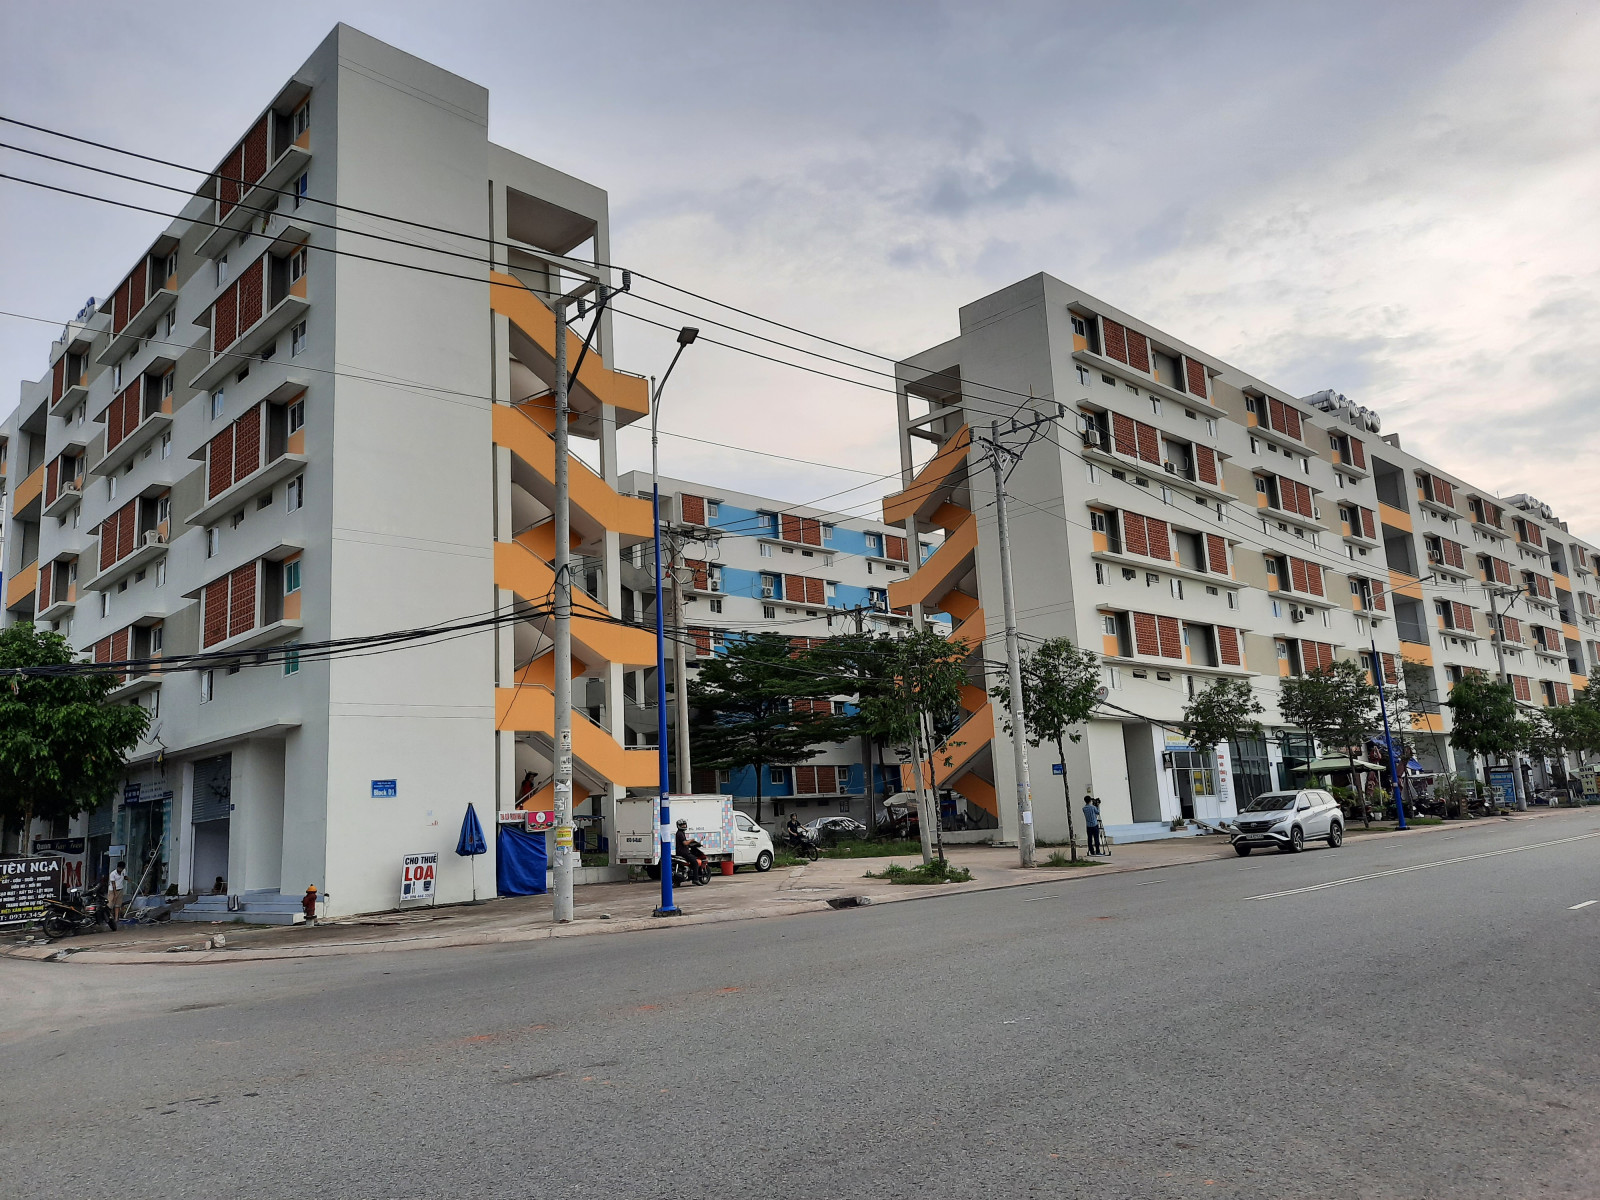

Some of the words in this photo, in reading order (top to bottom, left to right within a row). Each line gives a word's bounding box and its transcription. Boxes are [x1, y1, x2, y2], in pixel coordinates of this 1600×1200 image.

[0, 862, 26, 875] IÊN
[30, 861, 59, 872] NGA
[405, 857, 419, 865] CHO
[404, 865, 434, 881] LOA
